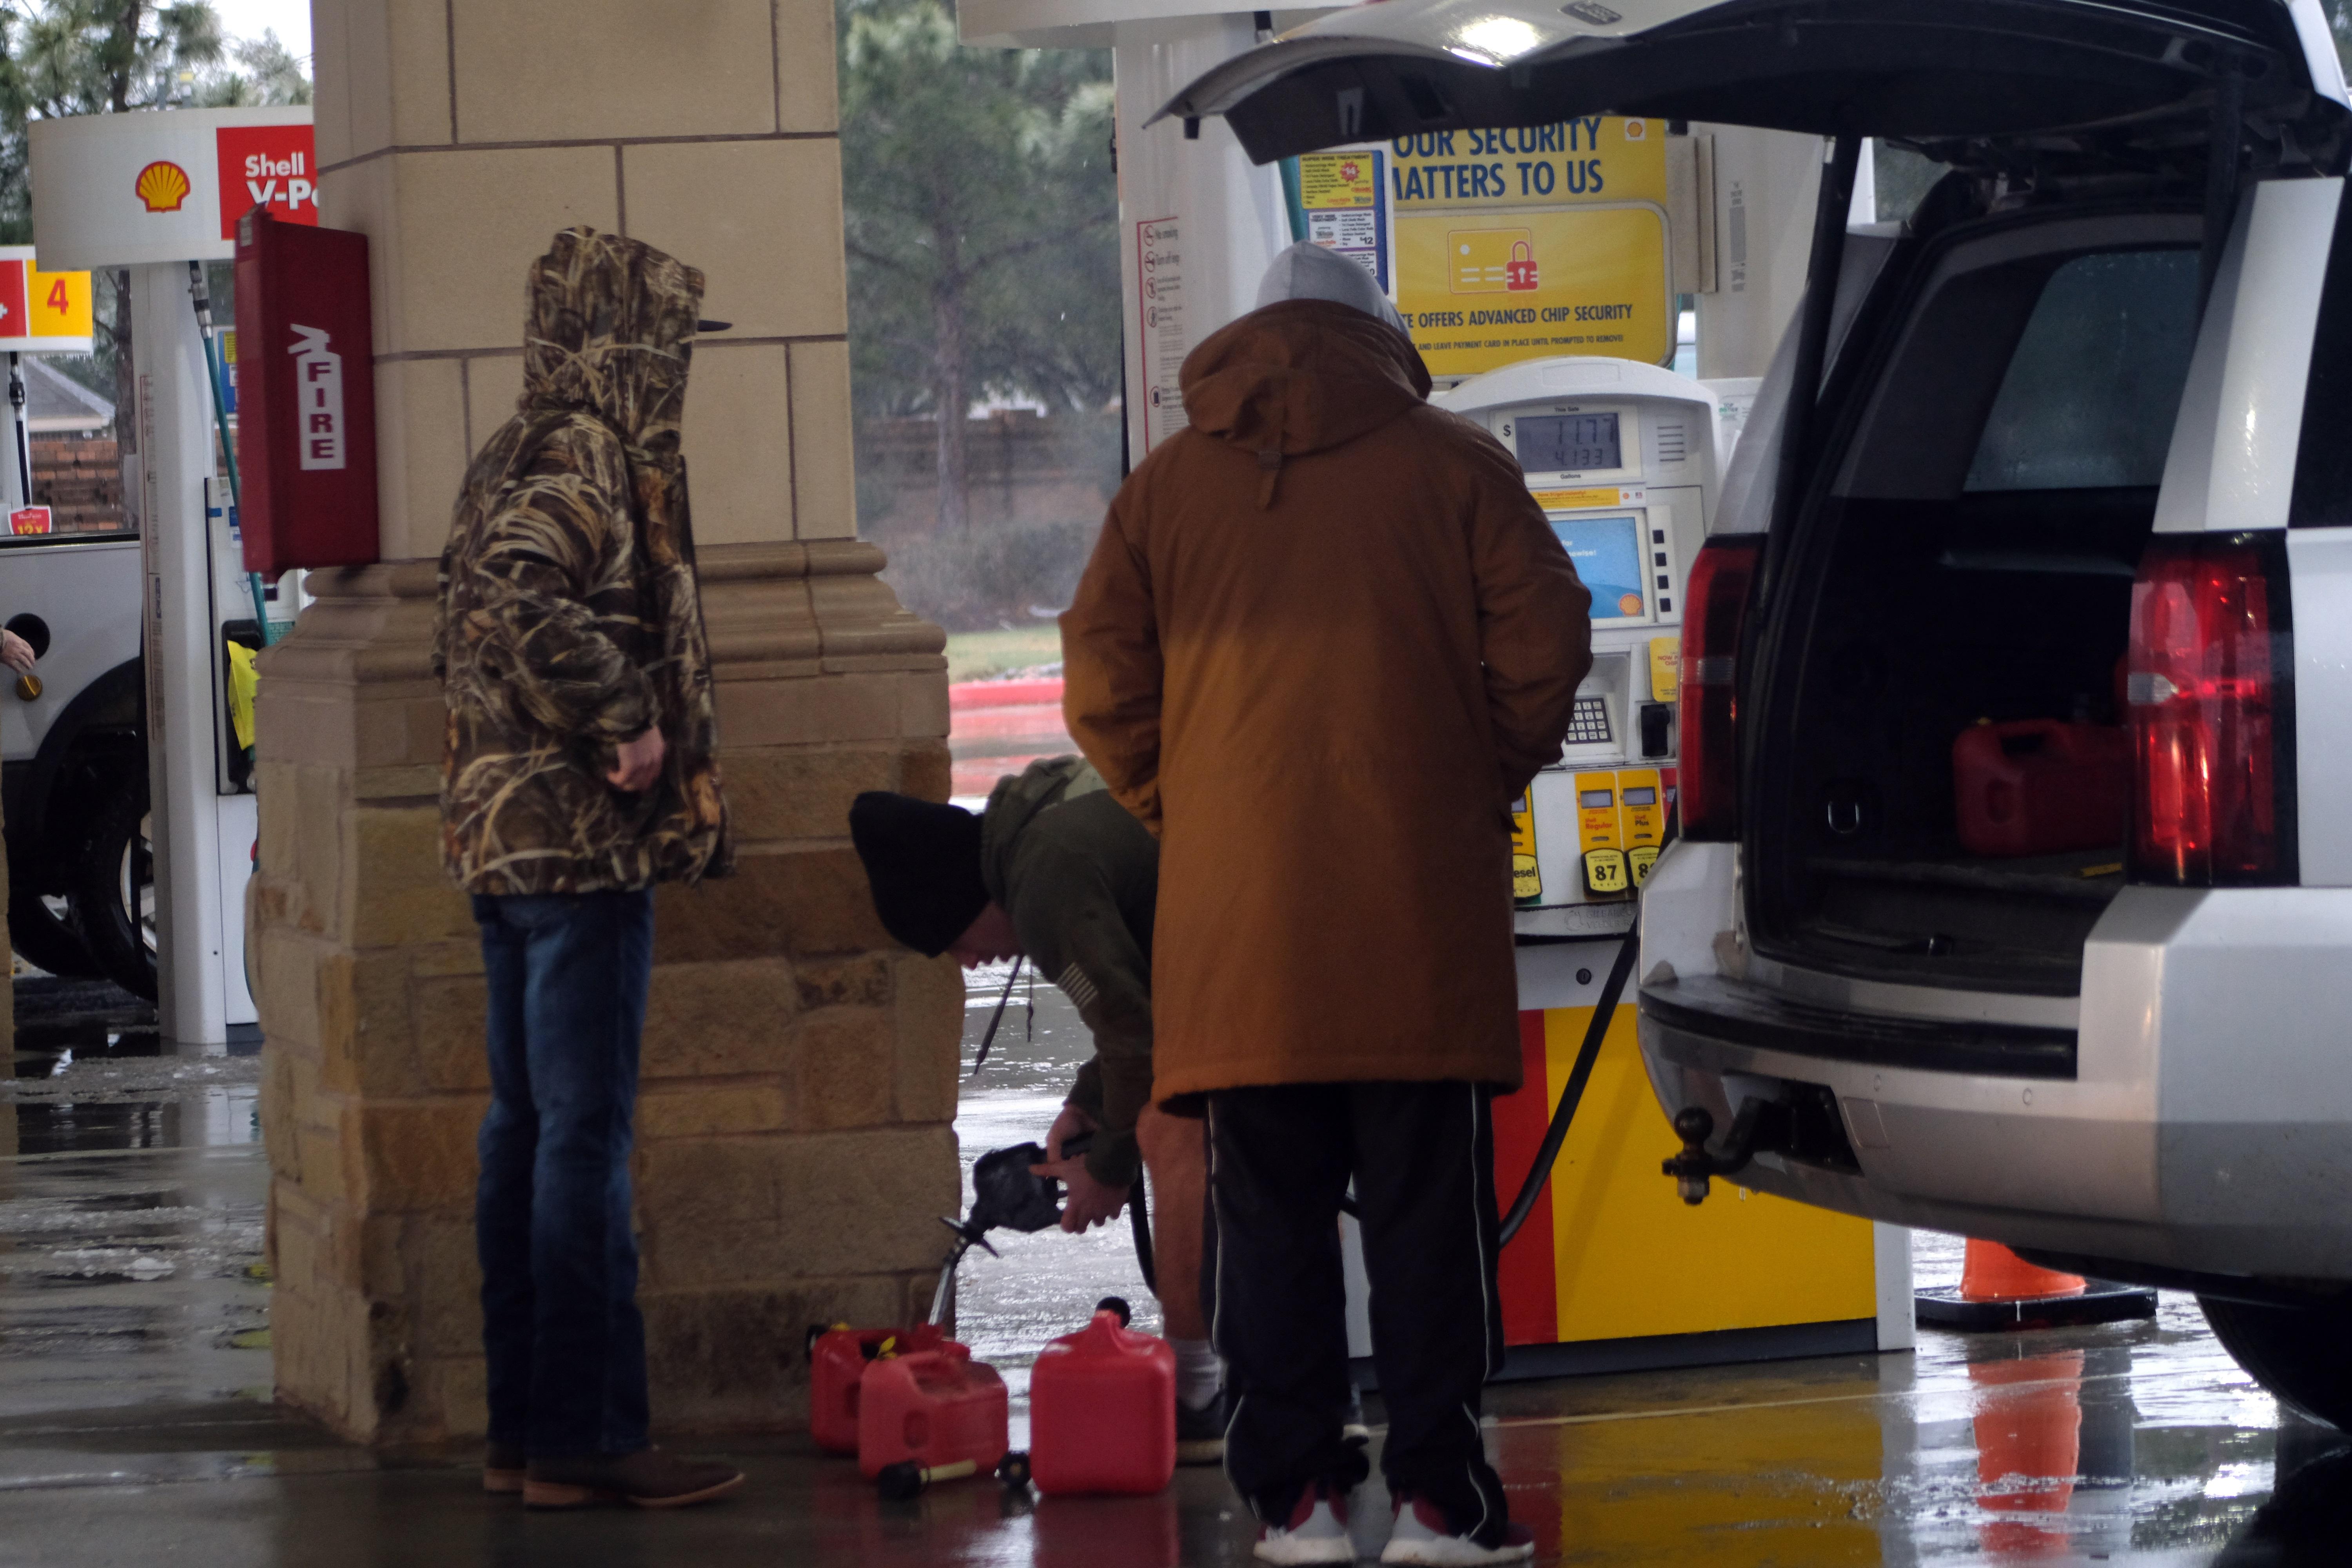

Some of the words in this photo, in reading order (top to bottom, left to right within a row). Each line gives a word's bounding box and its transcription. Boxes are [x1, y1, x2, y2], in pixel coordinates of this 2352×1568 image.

[1468, 118, 1602, 156] SECURITY
[245, 151, 304, 178] Shell
[1516, 161, 1555, 196] TO
[1566, 159, 1604, 194] US
[47, 279, 69, 316] 4
[1418, 311, 1464, 328] OFFERS
[1468, 309, 1536, 326] ADVANCED
[1541, 307, 1570, 323] CHIP
[1574, 303, 1633, 321] SECURITY
[1454, 340, 1481, 349] PAYMENT
[1512, 338, 1529, 346] PLACE
[1531, 337, 1549, 345] UNTIL
[1551, 336, 1584, 345] PROMPTED
[307, 361, 334, 459] FIRE
[1585, 822, 1612, 830] Regular
[1595, 865, 1617, 881] 87
